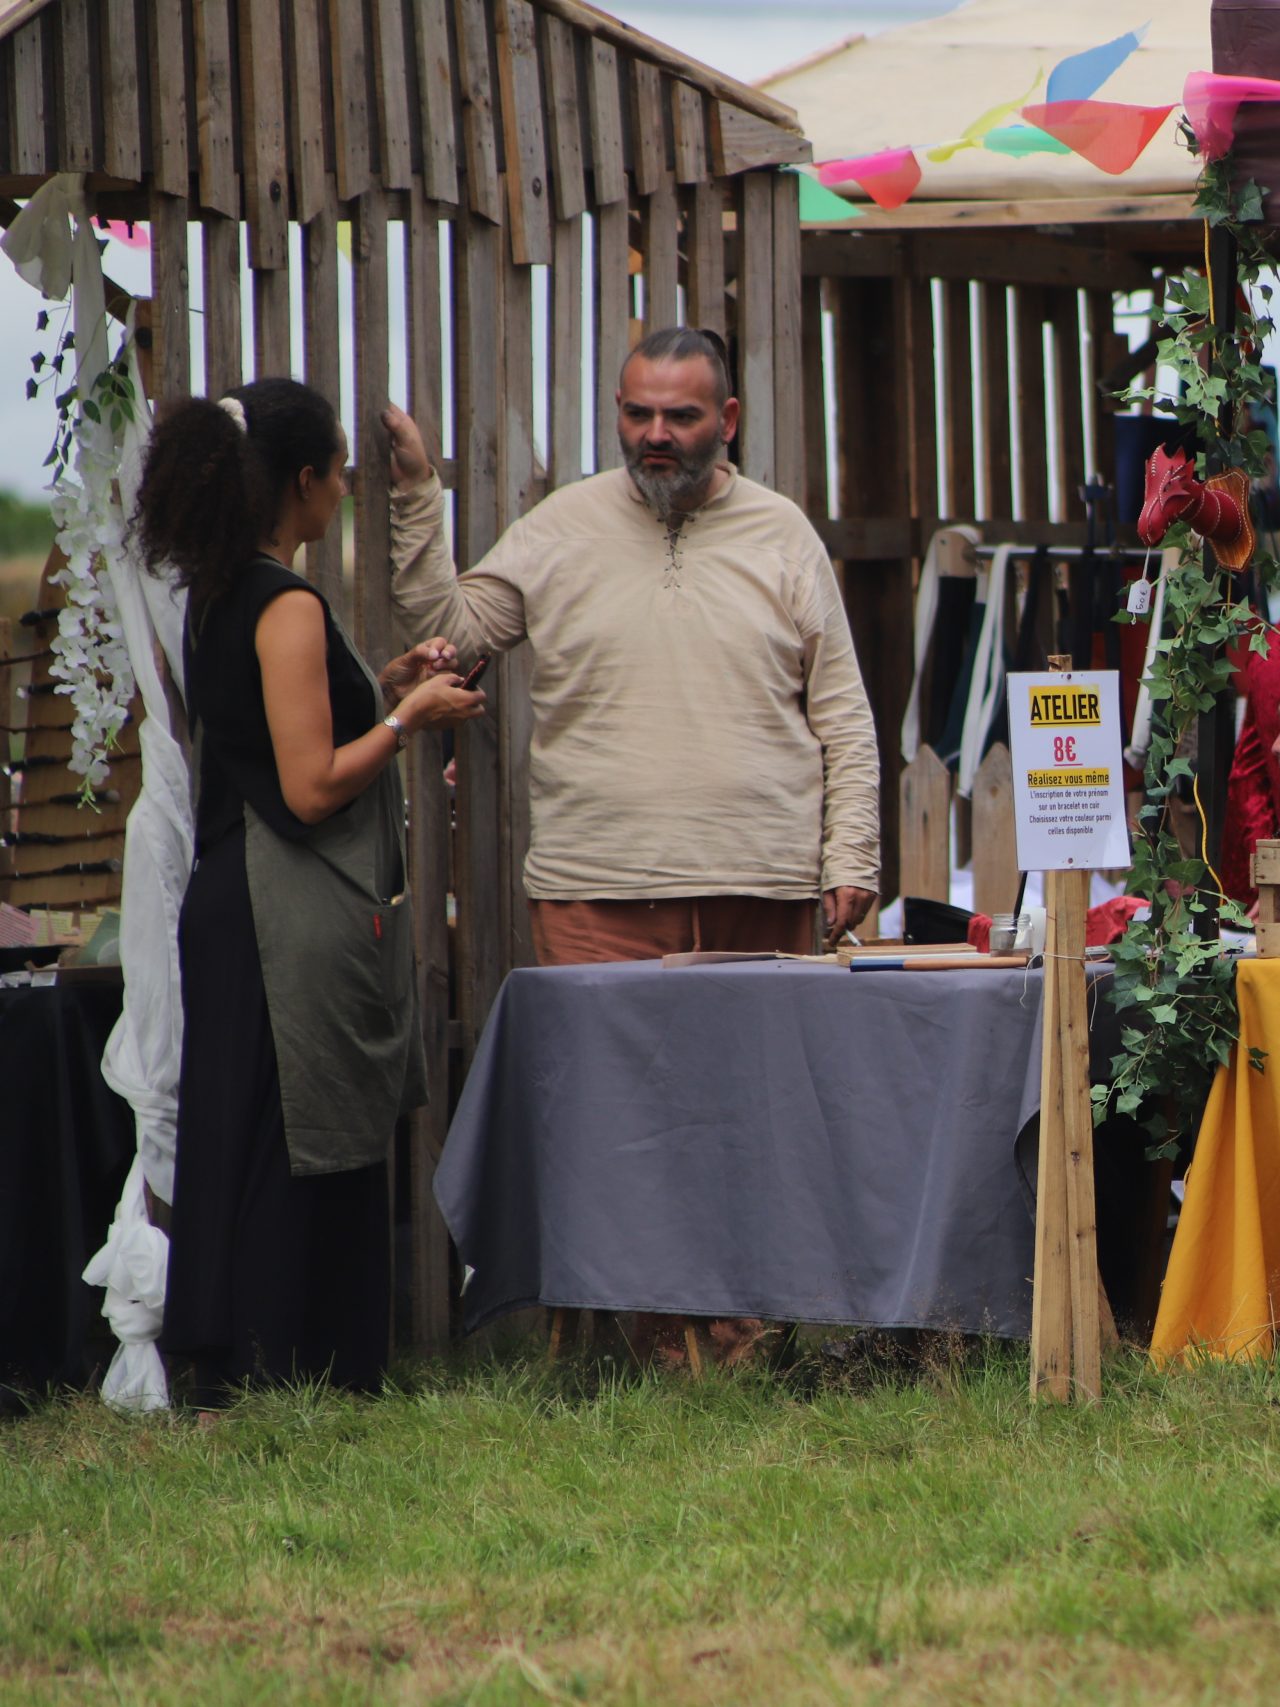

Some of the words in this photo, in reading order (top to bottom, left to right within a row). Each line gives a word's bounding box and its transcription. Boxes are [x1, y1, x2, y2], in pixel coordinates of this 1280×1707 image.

[1031, 694, 1100, 721] ATELIER
[1054, 736, 1076, 762] 8€
[1028, 772, 1062, 785] Réalisez
[1065, 774, 1083, 784] vous
[1086, 771, 1110, 783] même
[1030, 791, 1064, 800] L'inscription
[1065, 790, 1072, 798] de
[1088, 788, 1108, 798] prénom
[1058, 802, 1080, 810] bracelet
[1090, 801, 1100, 809] cuir
[1029, 815, 1057, 823] Choisissez
[1075, 814, 1095, 822] couleur
[1096, 813, 1111, 823] parmi
[1048, 826, 1065, 835] celles
[1066, 826, 1093, 835] disponible
